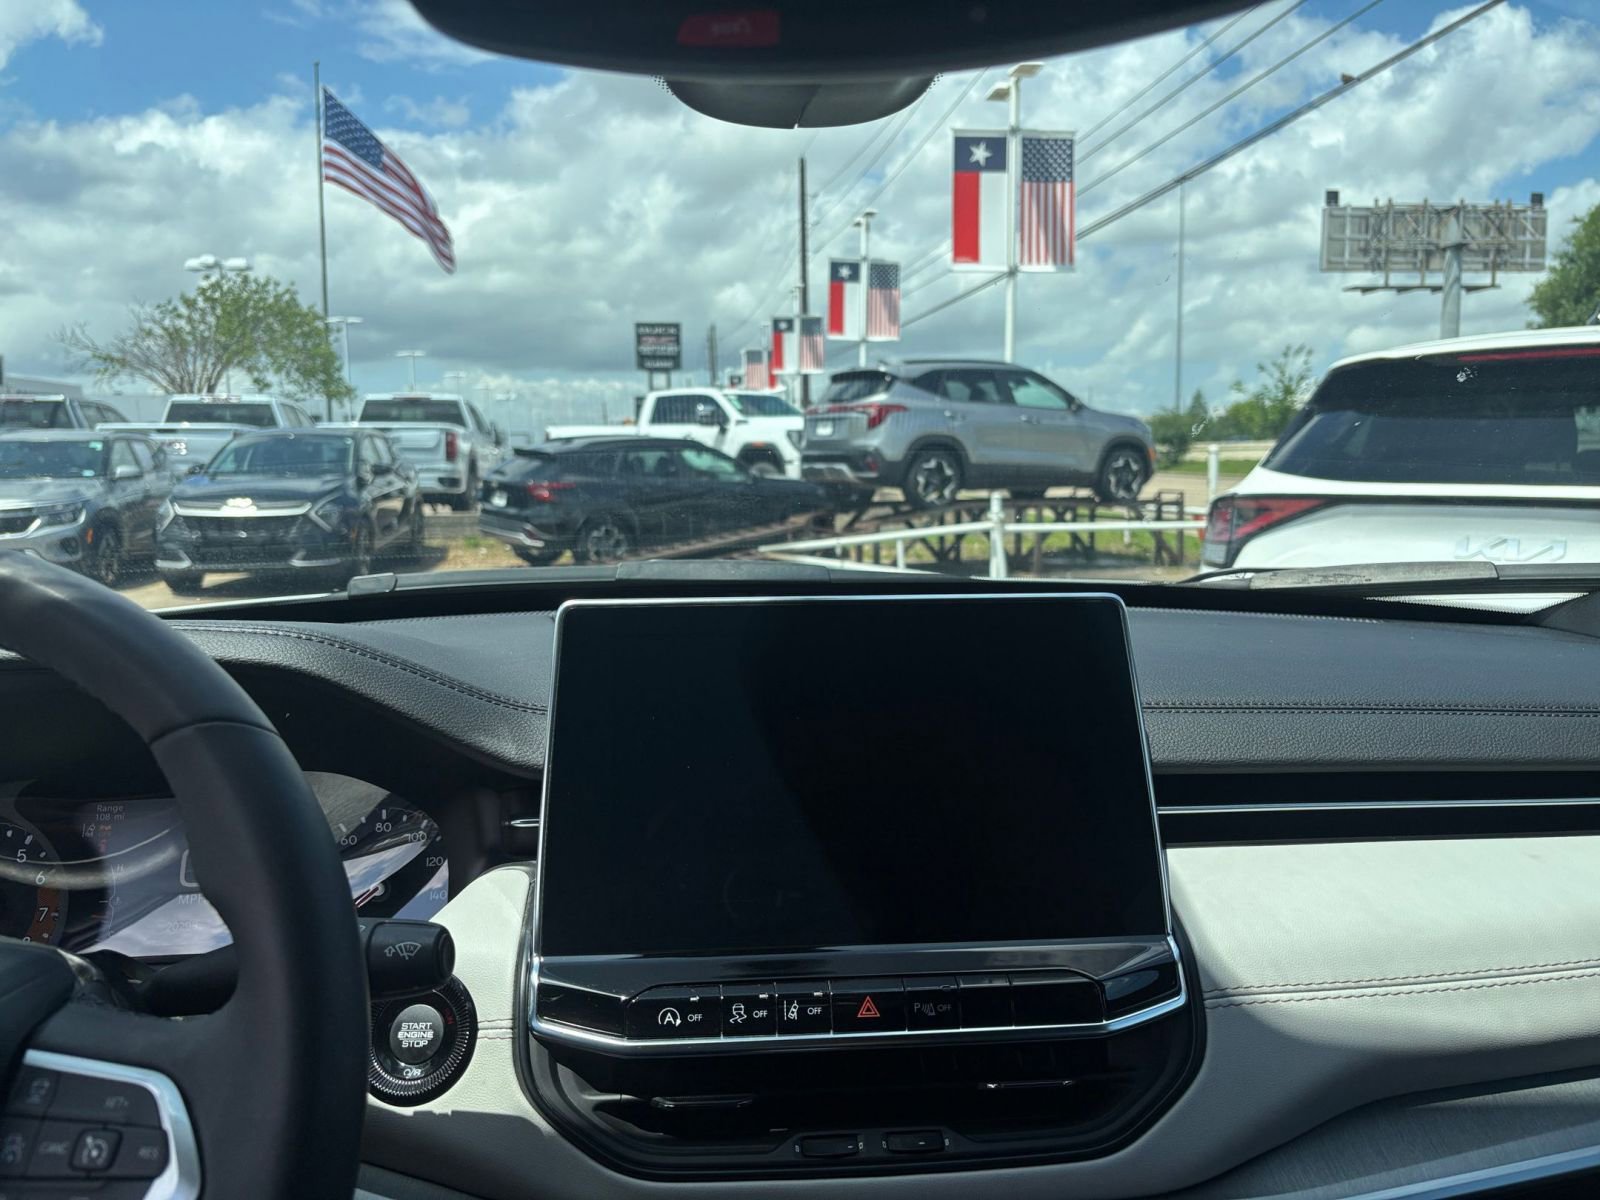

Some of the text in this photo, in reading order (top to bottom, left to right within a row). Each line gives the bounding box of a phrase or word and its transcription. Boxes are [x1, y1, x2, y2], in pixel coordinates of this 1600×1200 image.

[97, 804, 124, 815] Range
[96, 811, 125, 821] 108 mi
[375, 822, 392, 833] 80
[340, 834, 358, 846] 60
[407, 831, 428, 842] 100
[16, 849, 27, 863] 5
[425, 856, 444, 867] 120
[35, 871, 46, 885] 6
[430, 889, 447, 901] 140
[39, 907, 48, 921] 7
[753, 1010, 768, 1018] OFF
[807, 1007, 822, 1015] OFF
[687, 1014, 703, 1022] OFF
[401, 1022, 432, 1030] START
[397, 1031, 434, 1039] ENGINE
[401, 1040, 428, 1048] STOP
